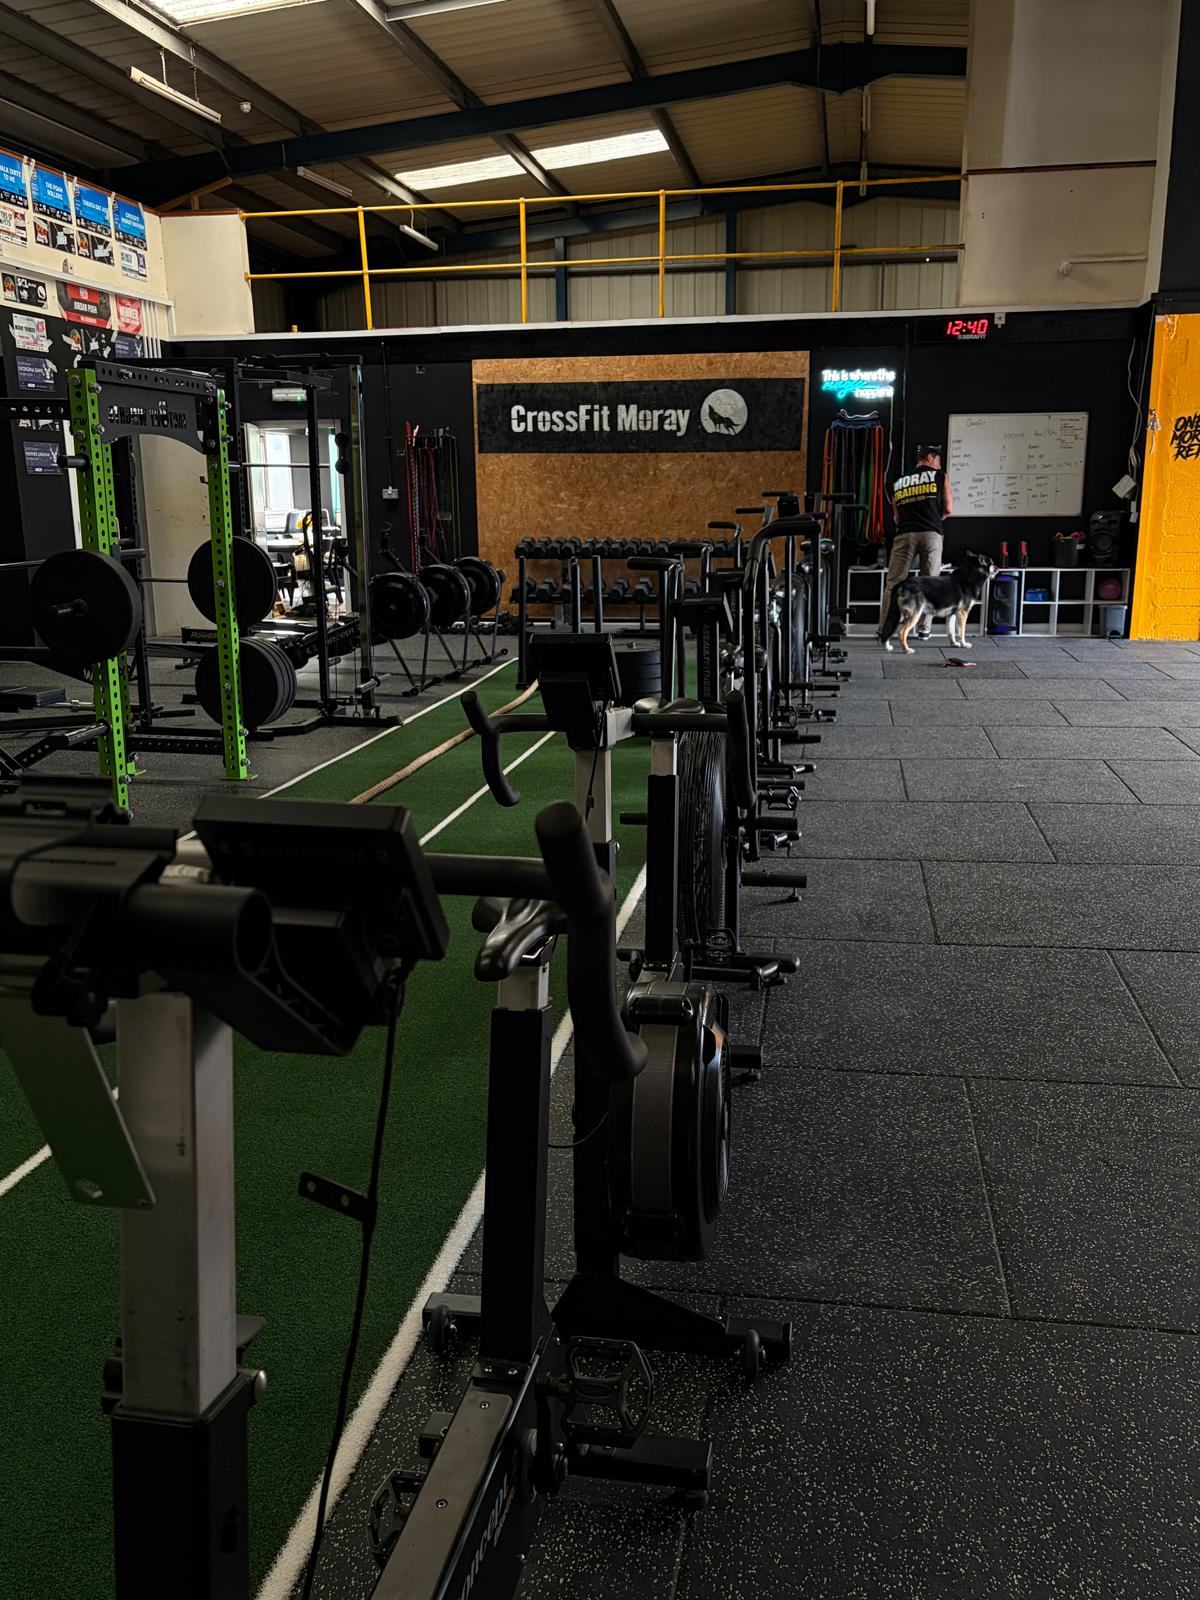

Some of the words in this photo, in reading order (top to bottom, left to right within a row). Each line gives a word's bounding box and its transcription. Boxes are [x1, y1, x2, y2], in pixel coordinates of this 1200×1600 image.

[946, 319, 988, 335] 12:40
[822, 369, 840, 382] This
[511, 404, 610, 433] CrossFit
[617, 403, 690, 437] Moray
[894, 470, 937, 492] MORAY
